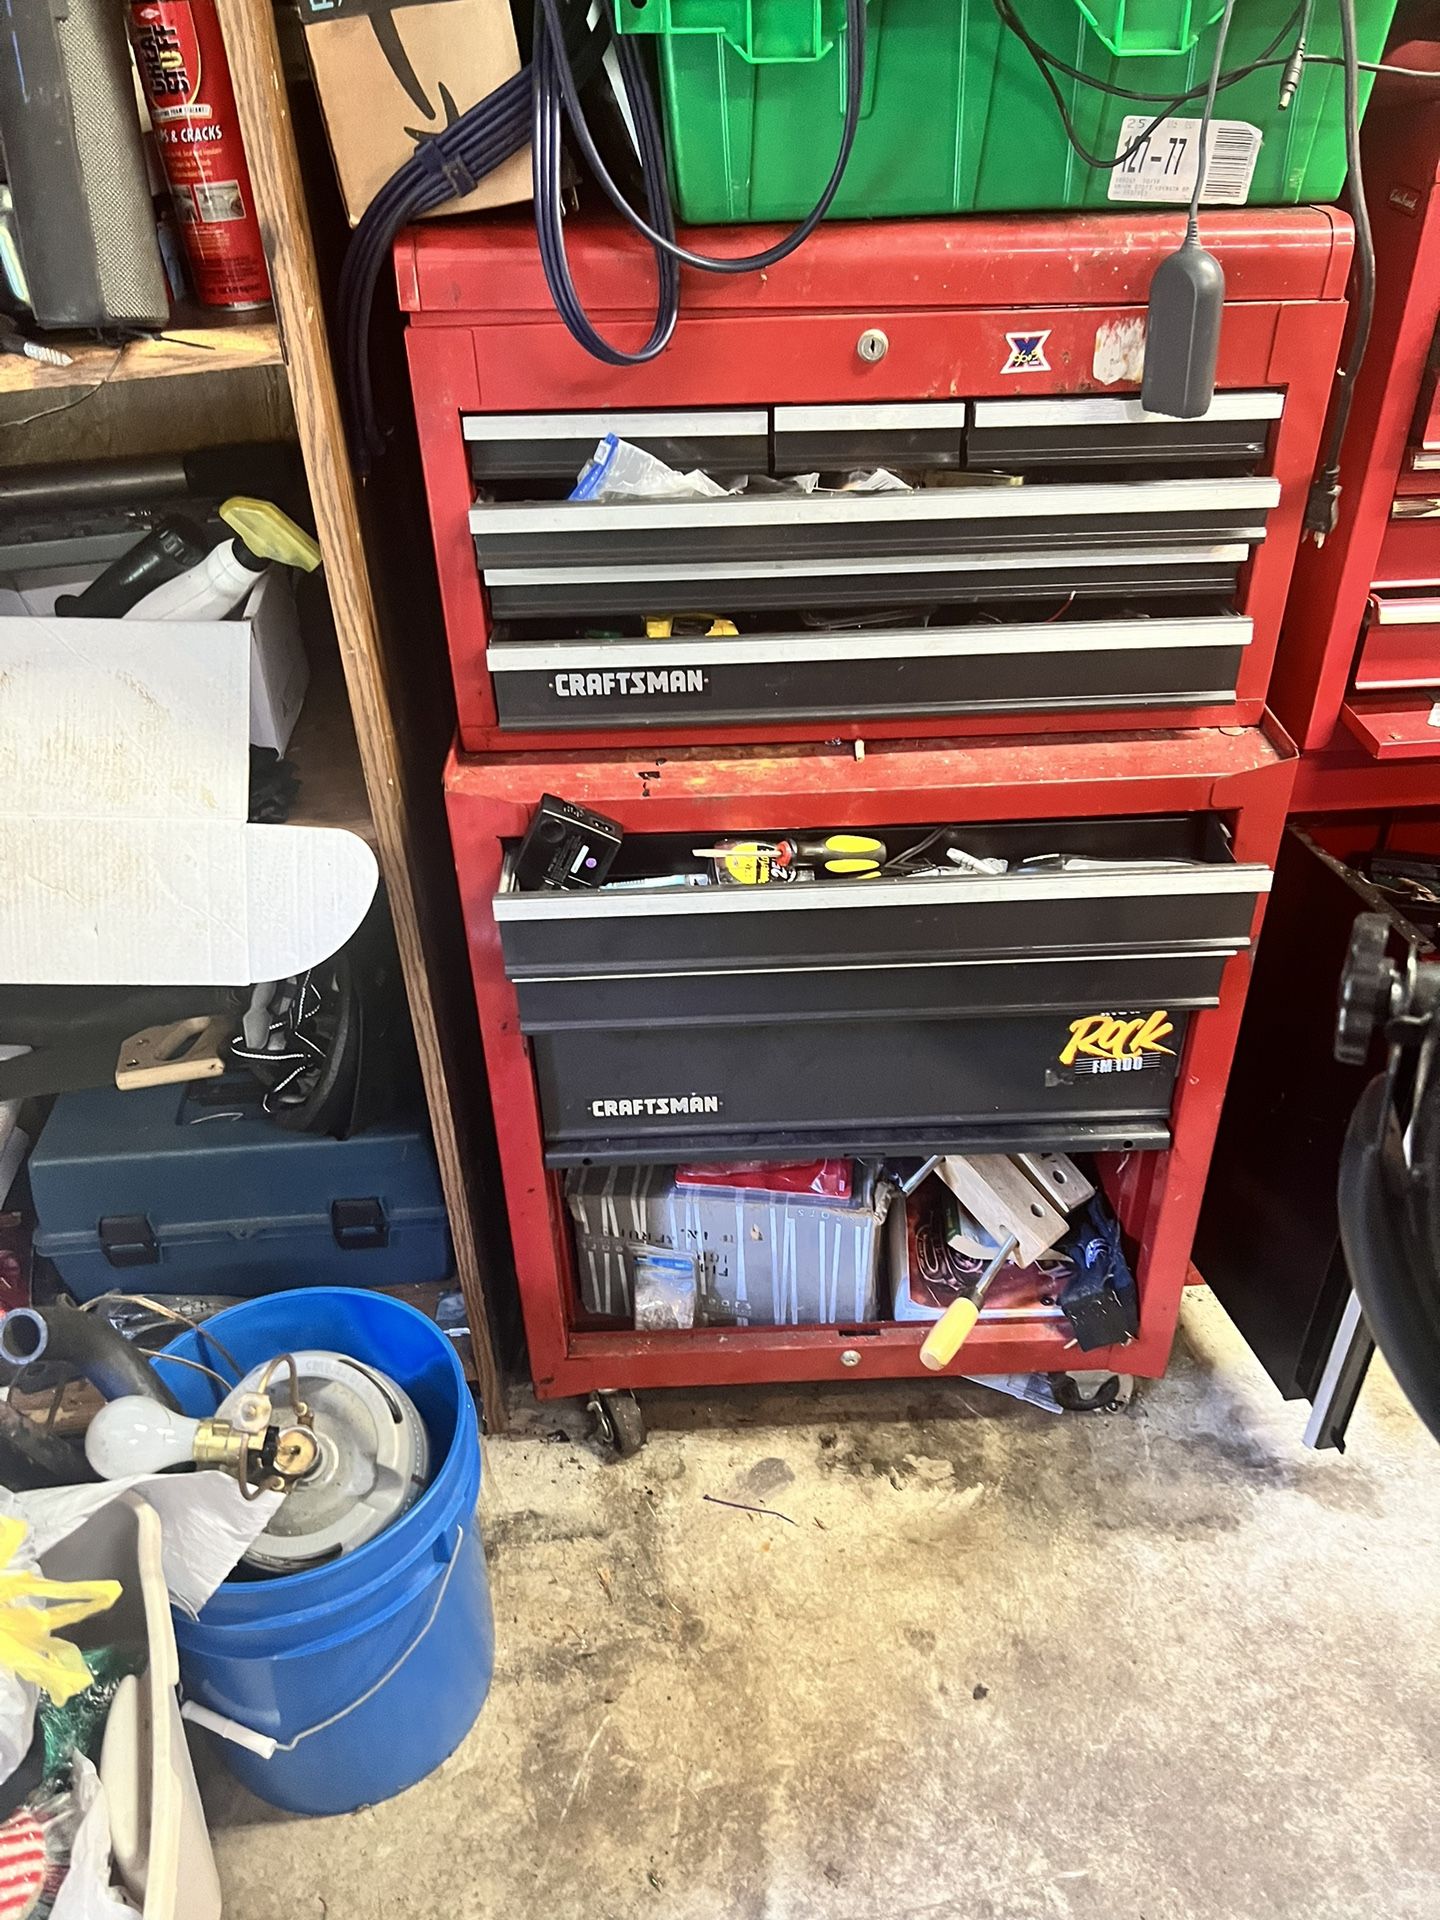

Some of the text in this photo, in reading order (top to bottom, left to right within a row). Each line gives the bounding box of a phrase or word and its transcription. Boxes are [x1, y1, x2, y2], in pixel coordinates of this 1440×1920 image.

[153, 23, 191, 95] STUFF
[180, 125, 223, 143] CRACKS
[1126, 118, 1146, 129] 25
[554, 670, 704, 697] CRAFTSMAN
[592, 1096, 719, 1117] CRAFTSMAN
